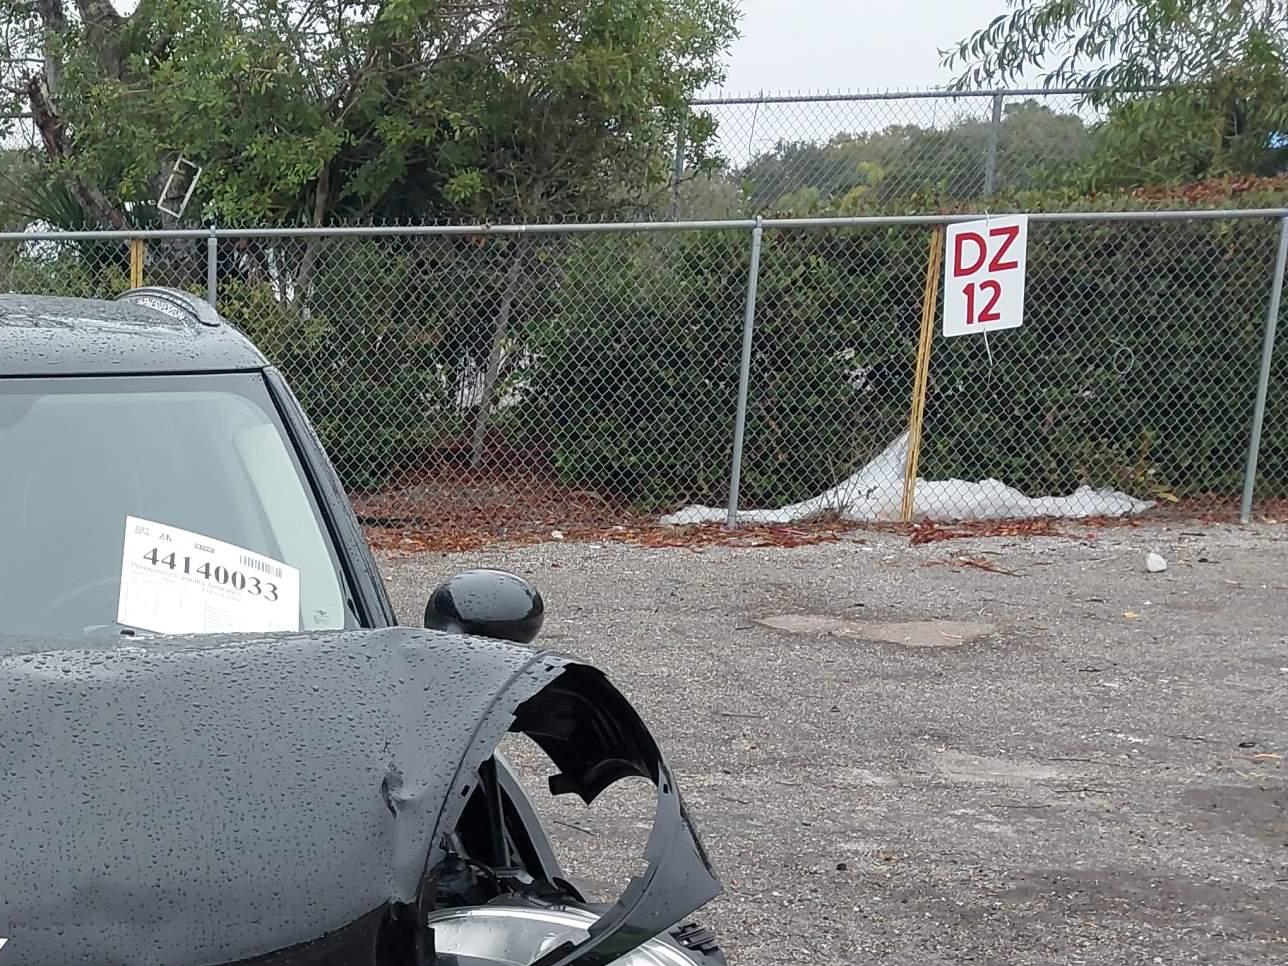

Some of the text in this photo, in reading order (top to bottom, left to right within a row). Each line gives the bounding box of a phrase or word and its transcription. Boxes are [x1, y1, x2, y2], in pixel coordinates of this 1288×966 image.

[953, 225, 1020, 278] DZ
[961, 279, 1002, 325] 12
[142, 547, 279, 602] 44140033
